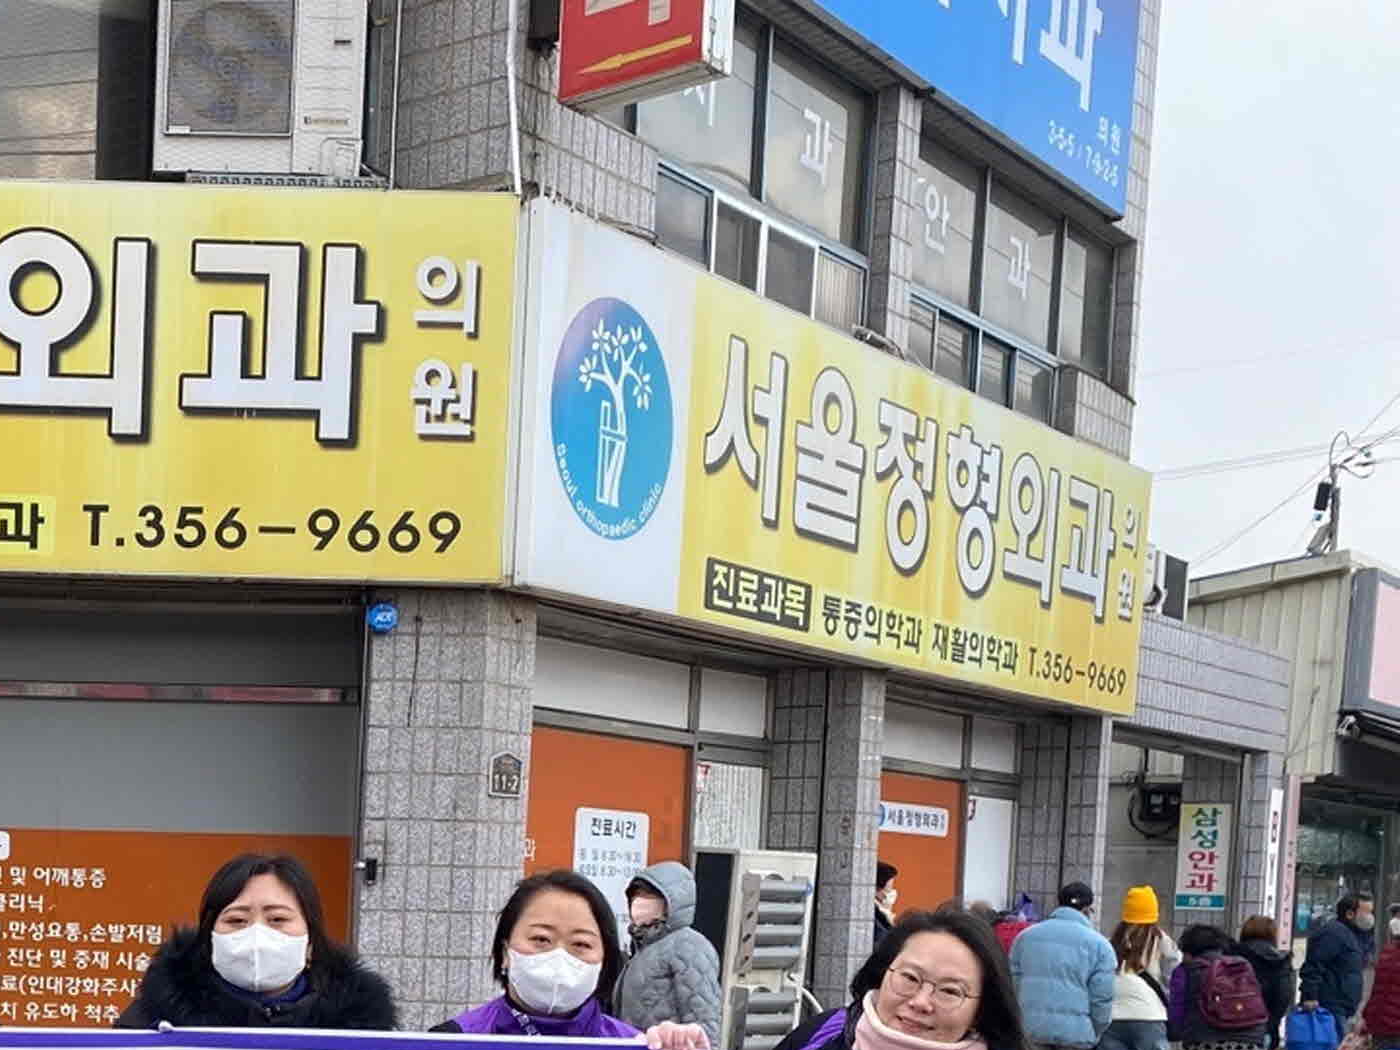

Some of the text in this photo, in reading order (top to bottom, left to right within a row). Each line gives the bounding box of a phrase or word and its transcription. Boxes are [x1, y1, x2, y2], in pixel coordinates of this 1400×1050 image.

[410, 255, 481, 440] 의원
[704, 334, 1117, 622] 서울정형외과
[82, 504, 463, 553] T.356-9669
[712, 564, 1127, 696] 진료과목 통증의학과 재활의학과 T.356-9669
[591, 817, 637, 839] 진료시간
[1185, 807, 1223, 892] 삼성안과
[9, 865, 28, 886] 및
[32, 866, 107, 889] 어깨통증
[7, 947, 43, 968] 진단
[49, 948, 67, 969] 및
[73, 950, 110, 971] 중재
[23, 1001, 79, 1022] 유도하
[84, 1002, 120, 1023] 척추
